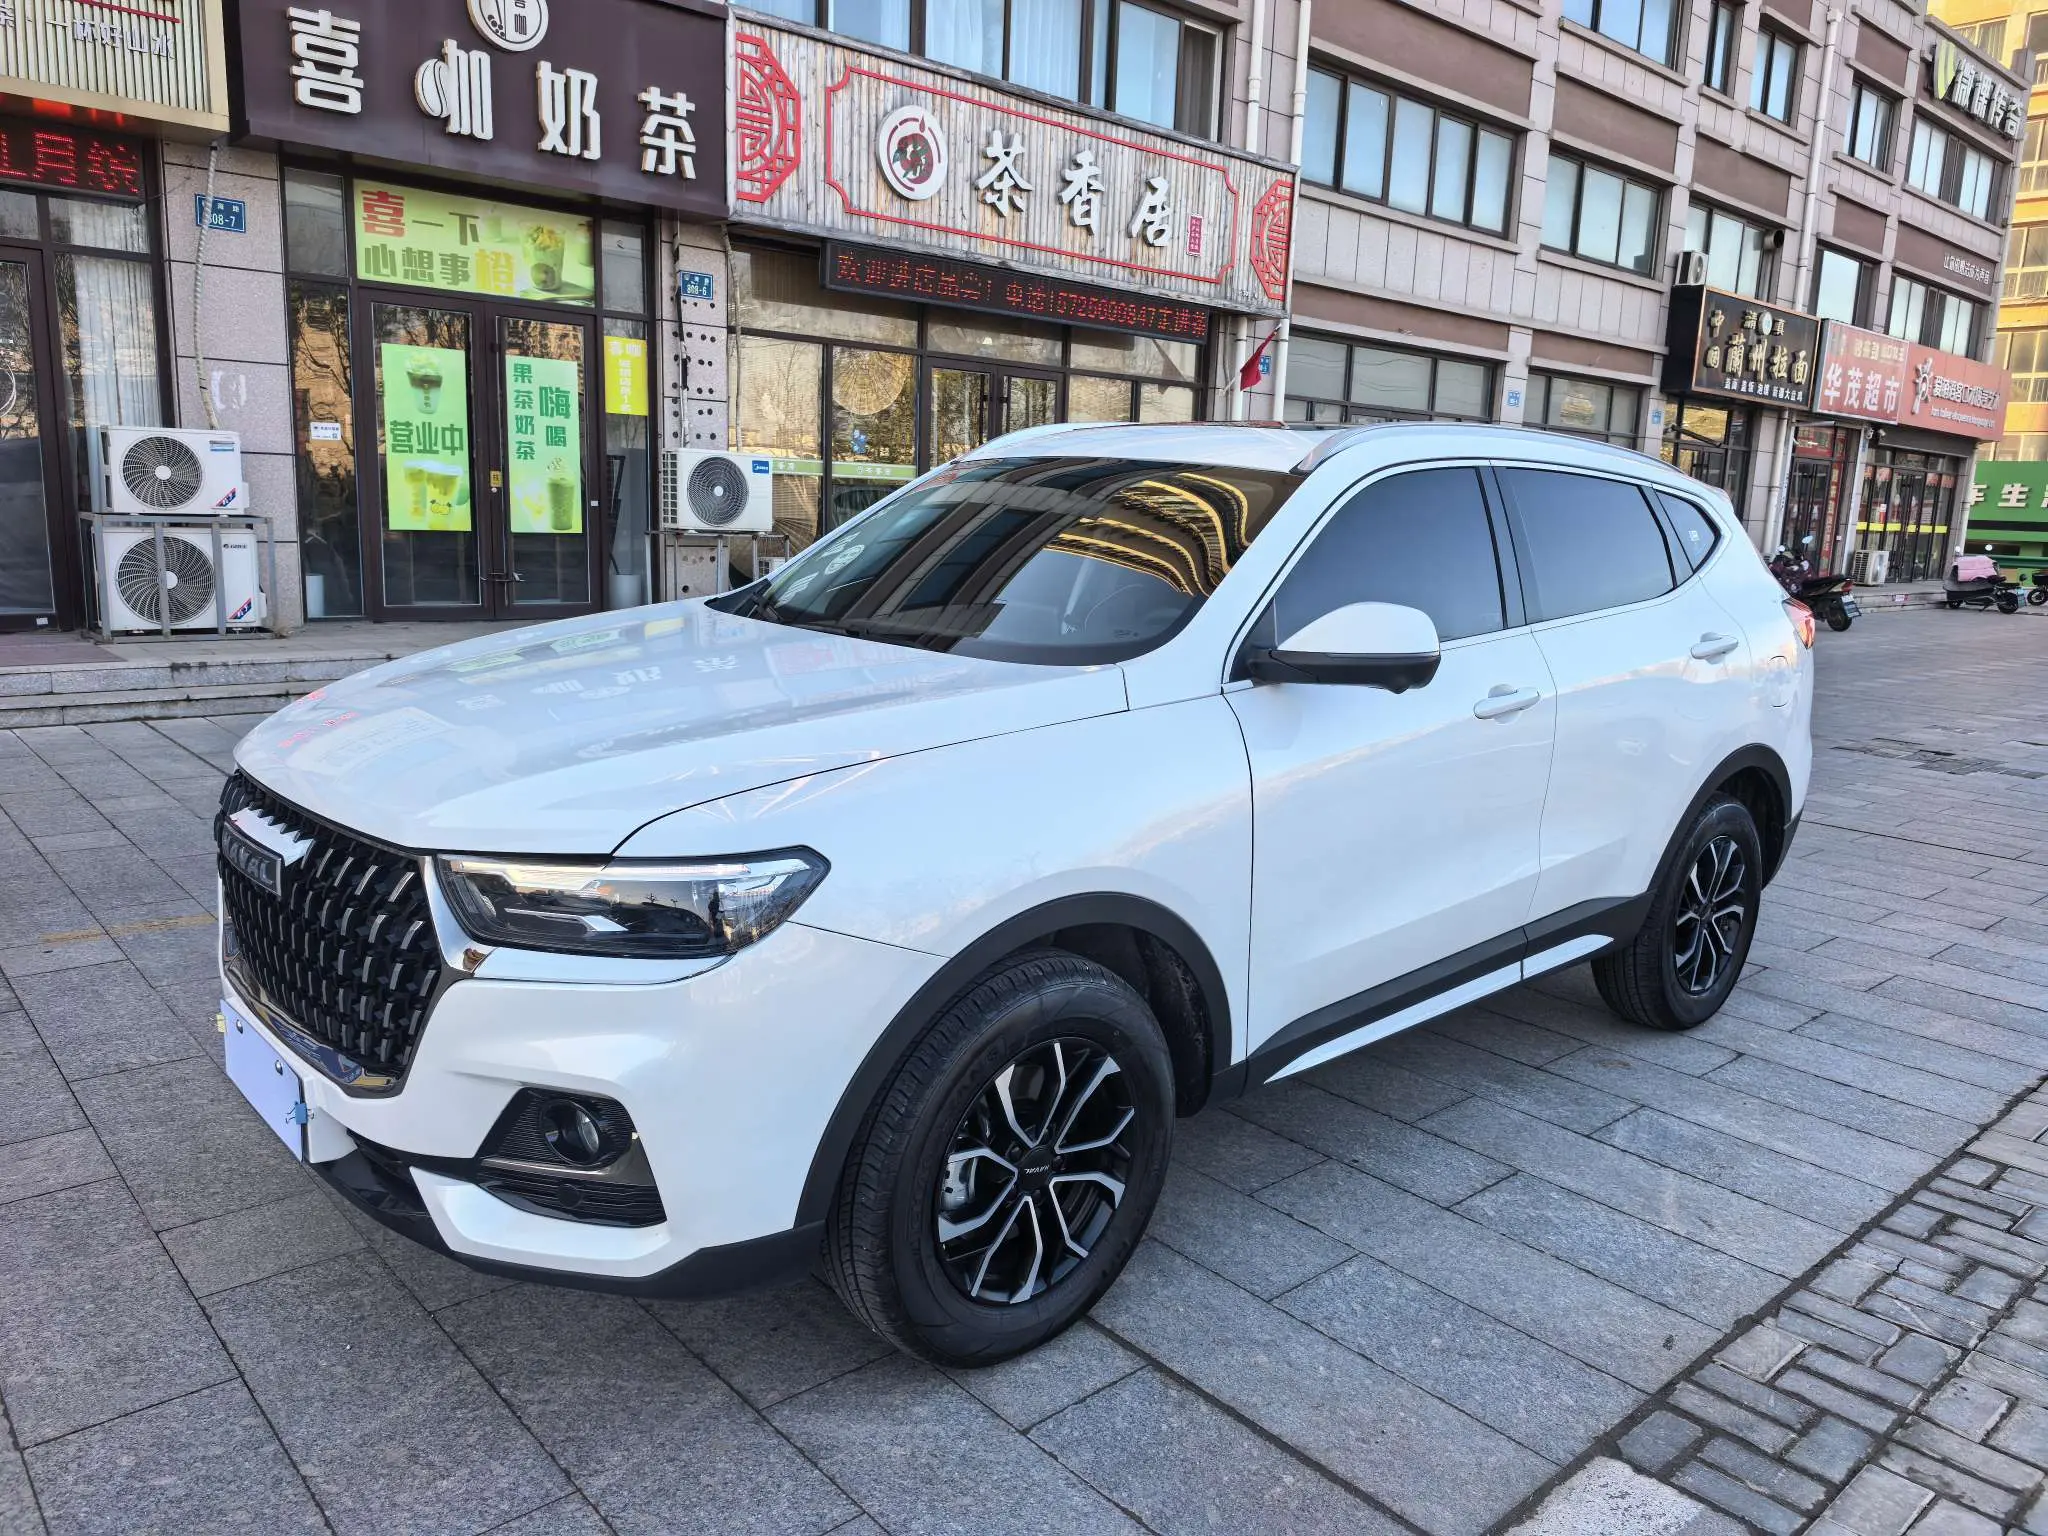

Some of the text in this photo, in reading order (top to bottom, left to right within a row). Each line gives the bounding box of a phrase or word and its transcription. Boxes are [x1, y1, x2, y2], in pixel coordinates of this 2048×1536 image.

[286, 5, 697, 180] 喜咖奶茶
[361, 190, 480, 246] 喜一下
[975, 129, 1174, 248] 茶香居
[364, 243, 516, 295] 心想事橙
[513, 362, 536, 460] 果茶奶茶
[538, 386, 571, 448] 嗨喝
[1824, 362, 1900, 414] 华茂超市
[390, 420, 464, 456] 营业中
